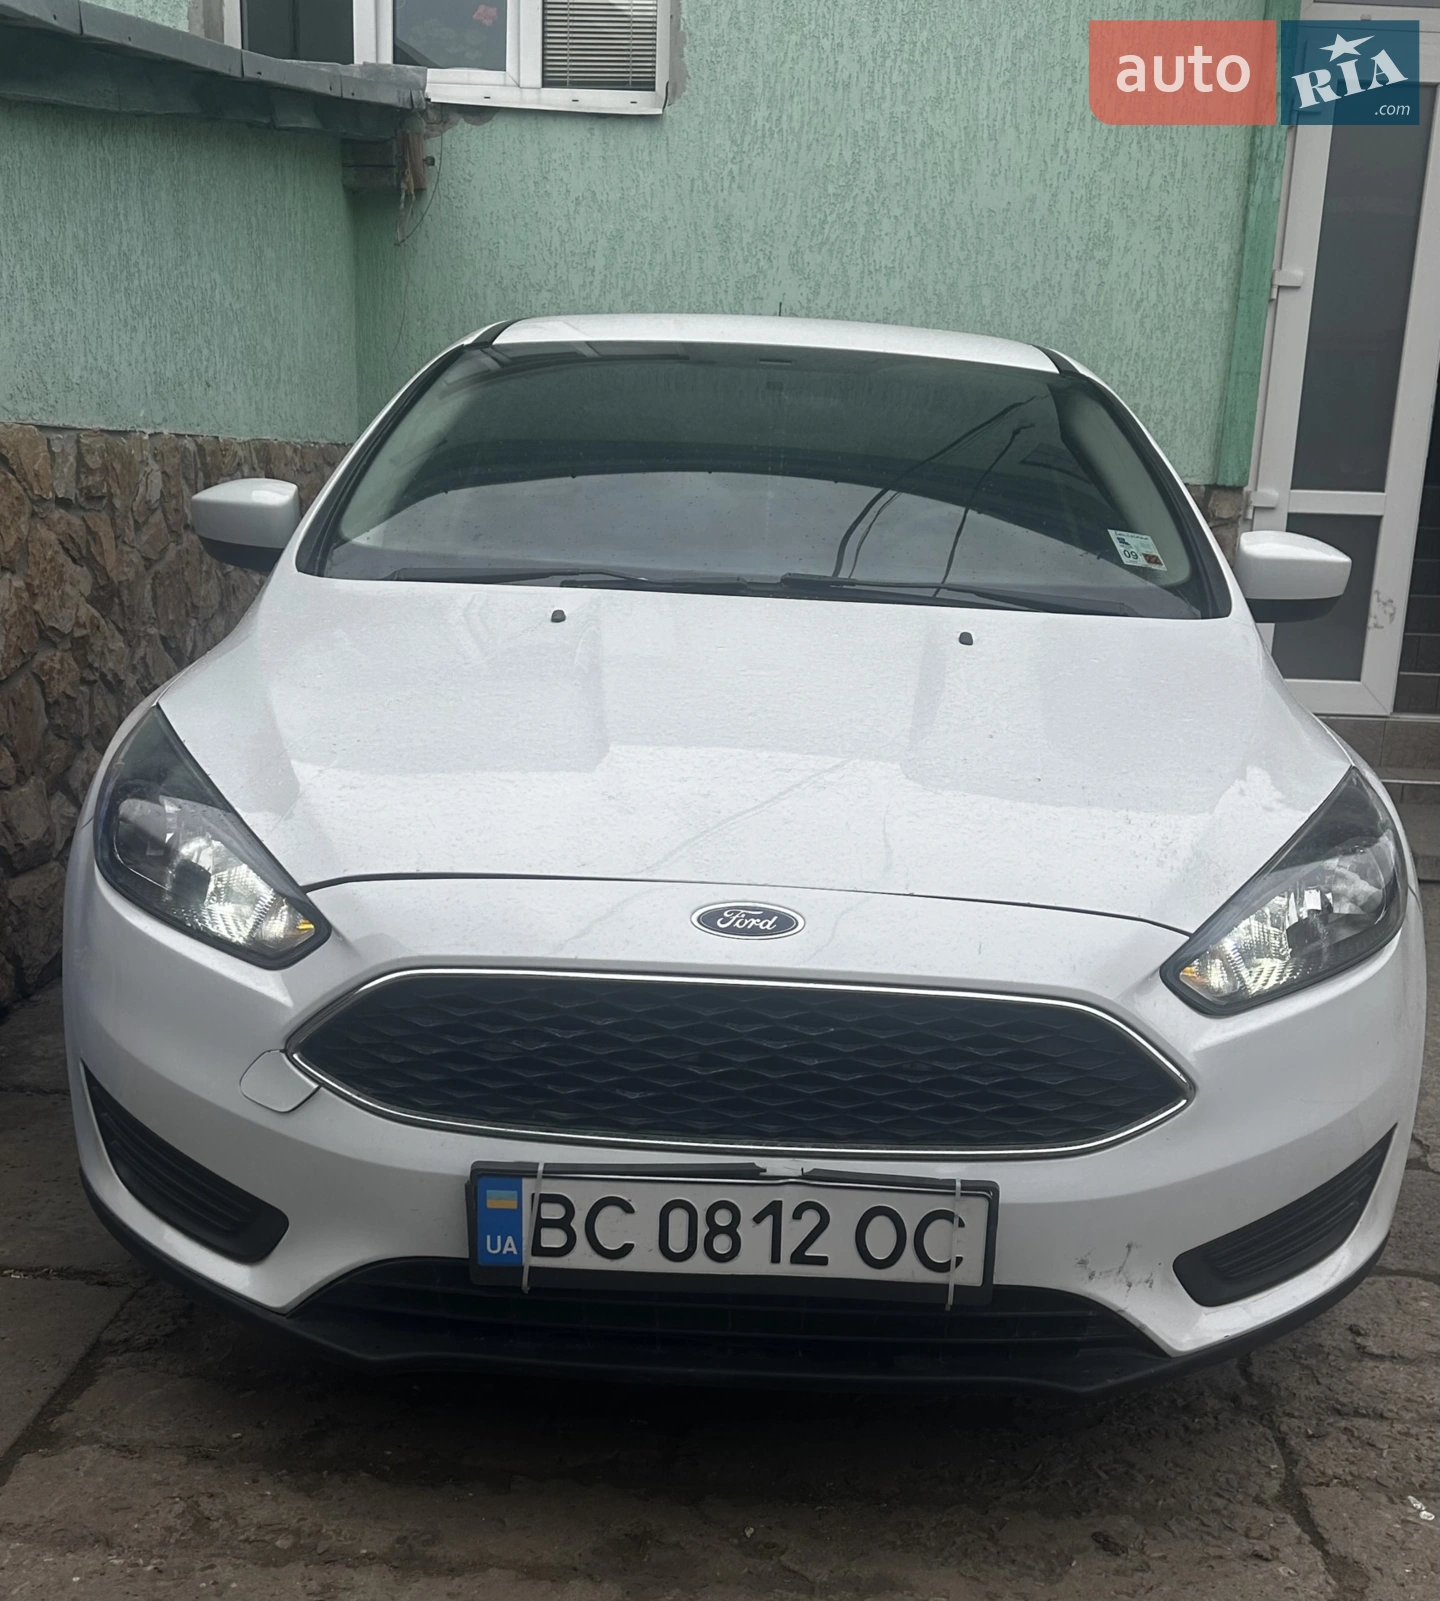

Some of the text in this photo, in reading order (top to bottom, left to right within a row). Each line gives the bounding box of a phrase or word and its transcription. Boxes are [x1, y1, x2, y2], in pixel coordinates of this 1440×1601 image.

[1123, 549, 1139, 560] 09
[716, 908, 778, 930] Ford
[531, 1193, 966, 1274] BC 0812 OC
[486, 1234, 518, 1255] UA
